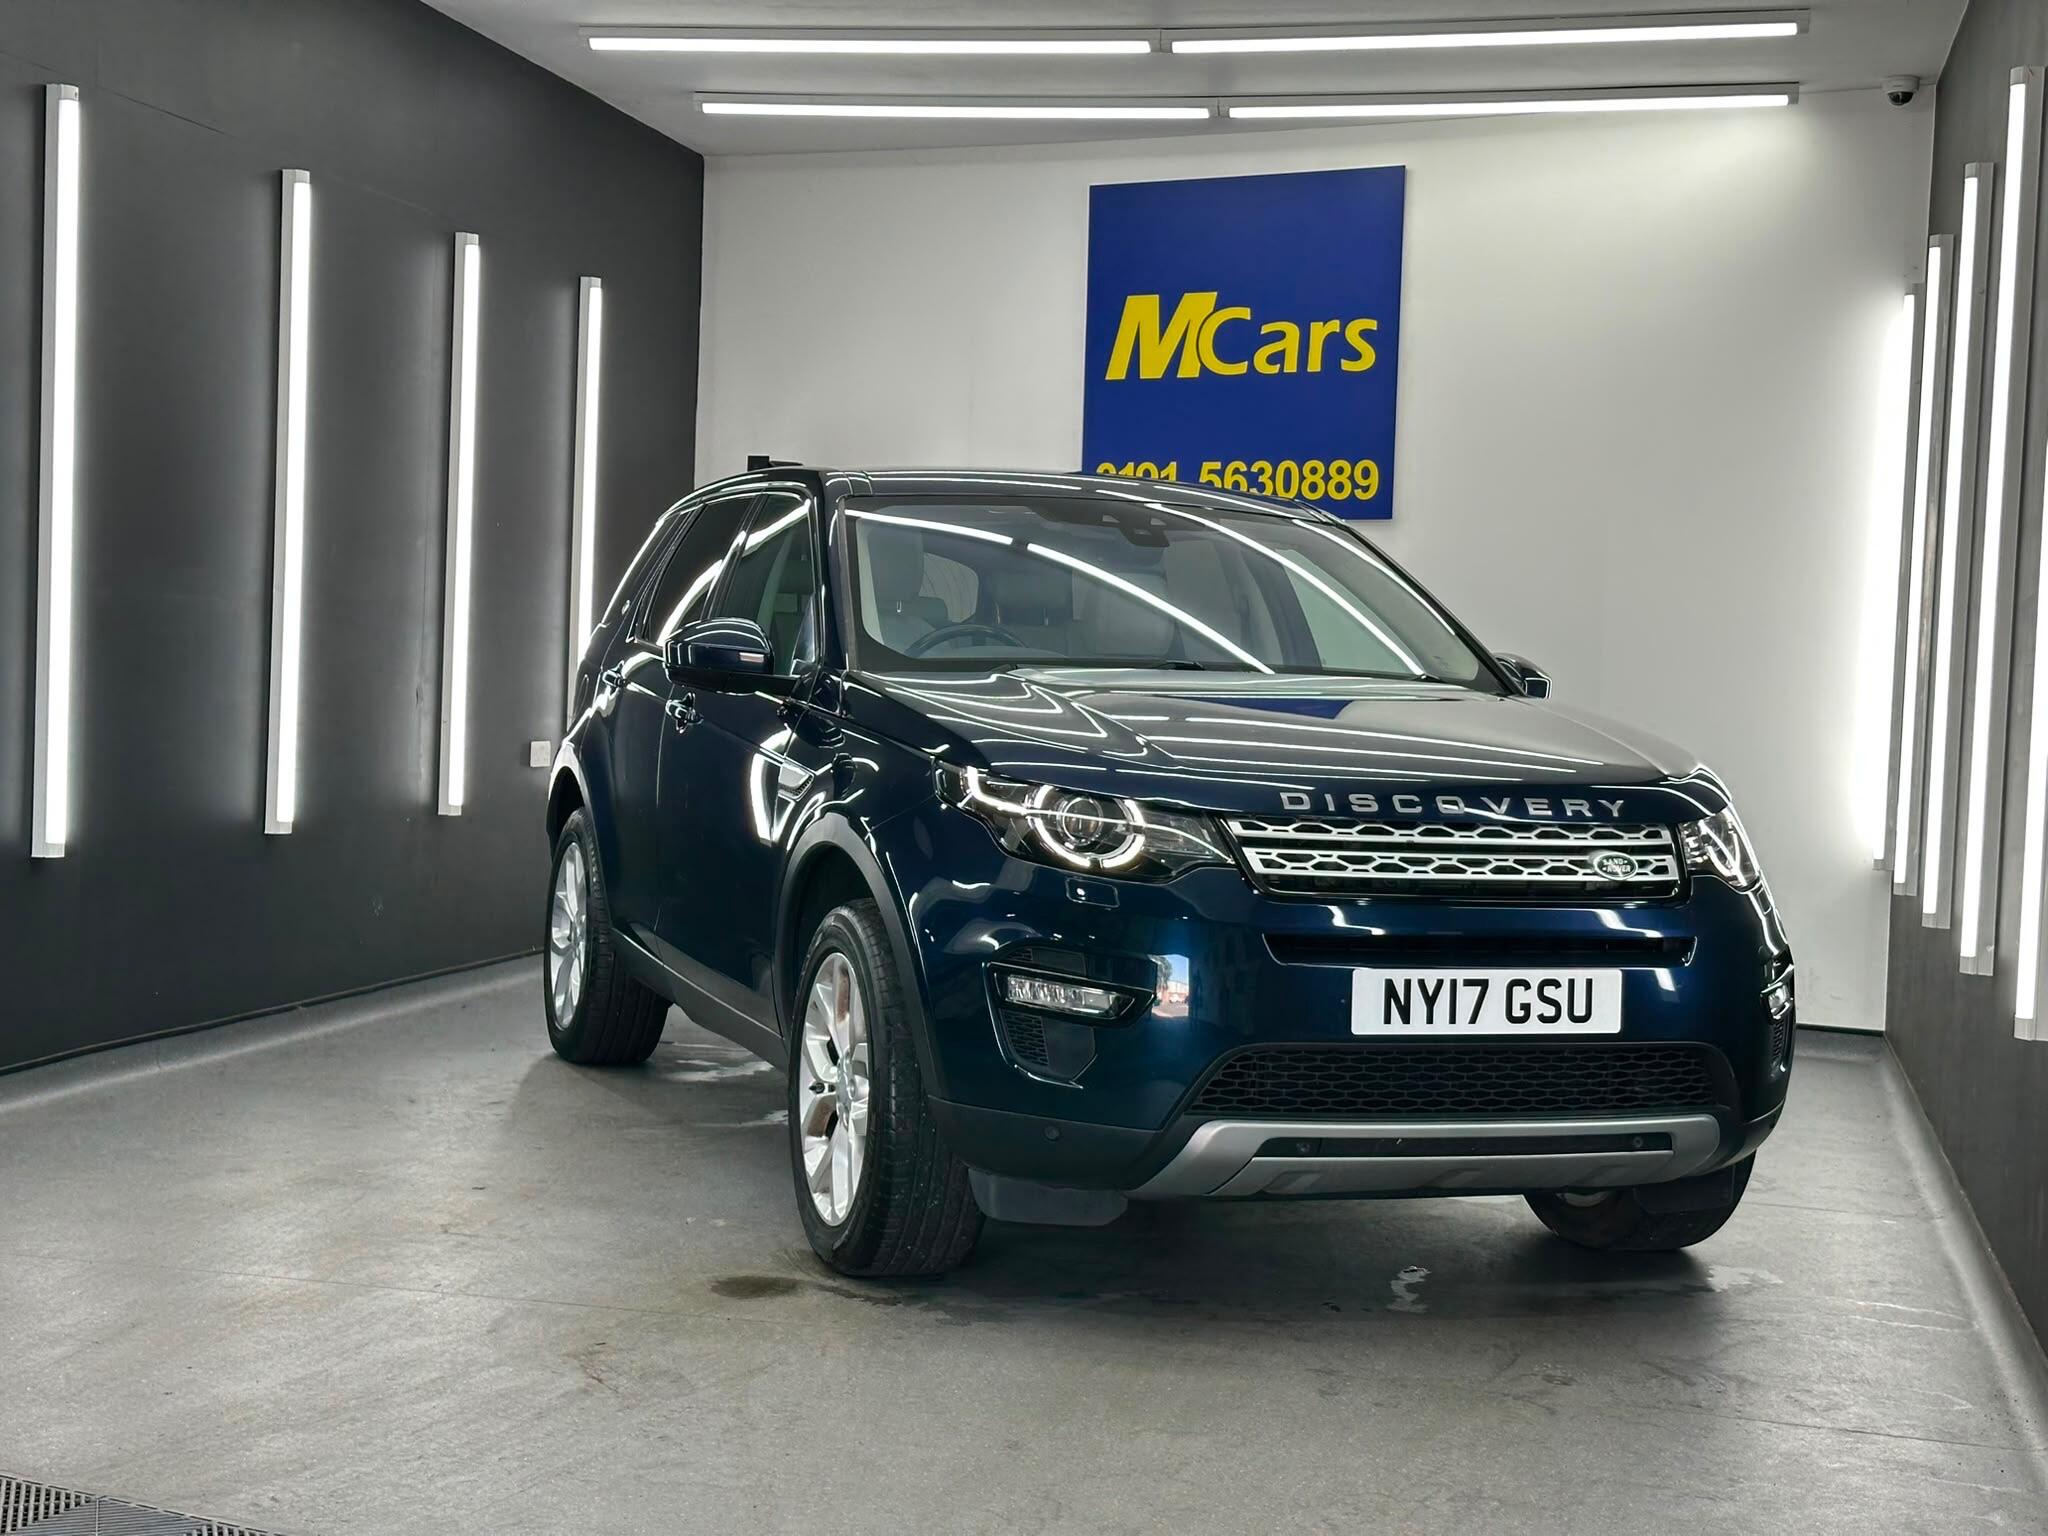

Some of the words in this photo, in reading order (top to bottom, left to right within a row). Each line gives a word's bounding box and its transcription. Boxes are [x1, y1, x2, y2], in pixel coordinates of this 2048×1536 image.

[1105, 291, 1378, 380] MCars
[1199, 459, 1379, 500] 5630889
[1279, 791, 1625, 818] DISCOVERY
[1383, 978, 1490, 1025] NY17
[1505, 978, 1593, 1025] GSU
